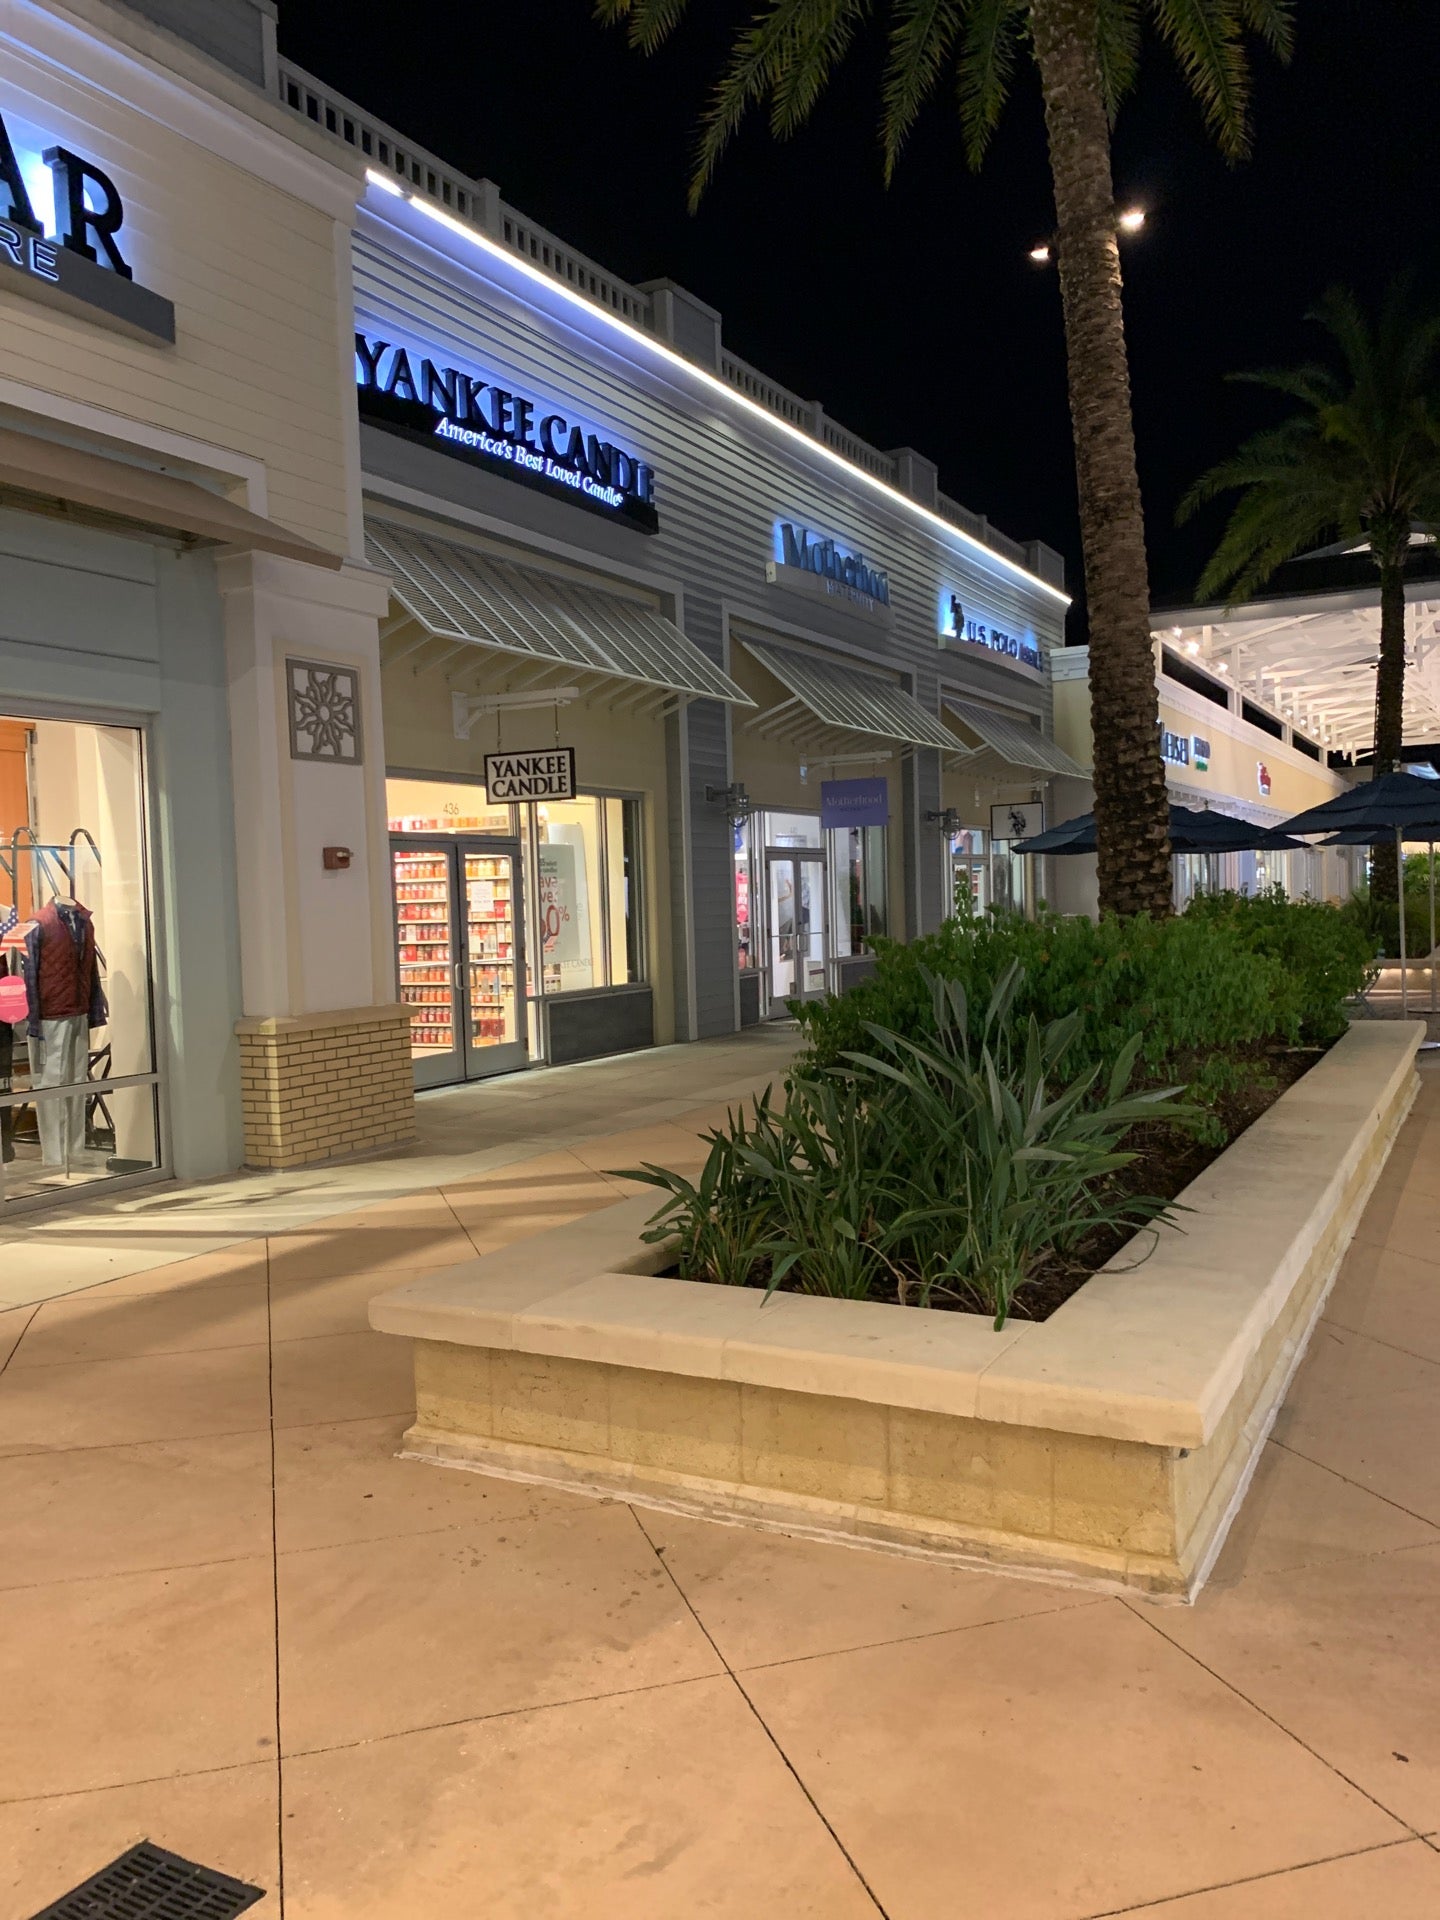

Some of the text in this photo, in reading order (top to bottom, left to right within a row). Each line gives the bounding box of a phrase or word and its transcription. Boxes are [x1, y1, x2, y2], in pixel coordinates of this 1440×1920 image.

[355, 332, 536, 446] YANKEE
[434, 416, 513, 460] America's
[514, 444, 545, 472] Best
[545, 457, 582, 489] Loved
[491, 755, 567, 778] YANKEE
[491, 775, 568, 798] CANDLE
[442, 802, 460, 815] 436
